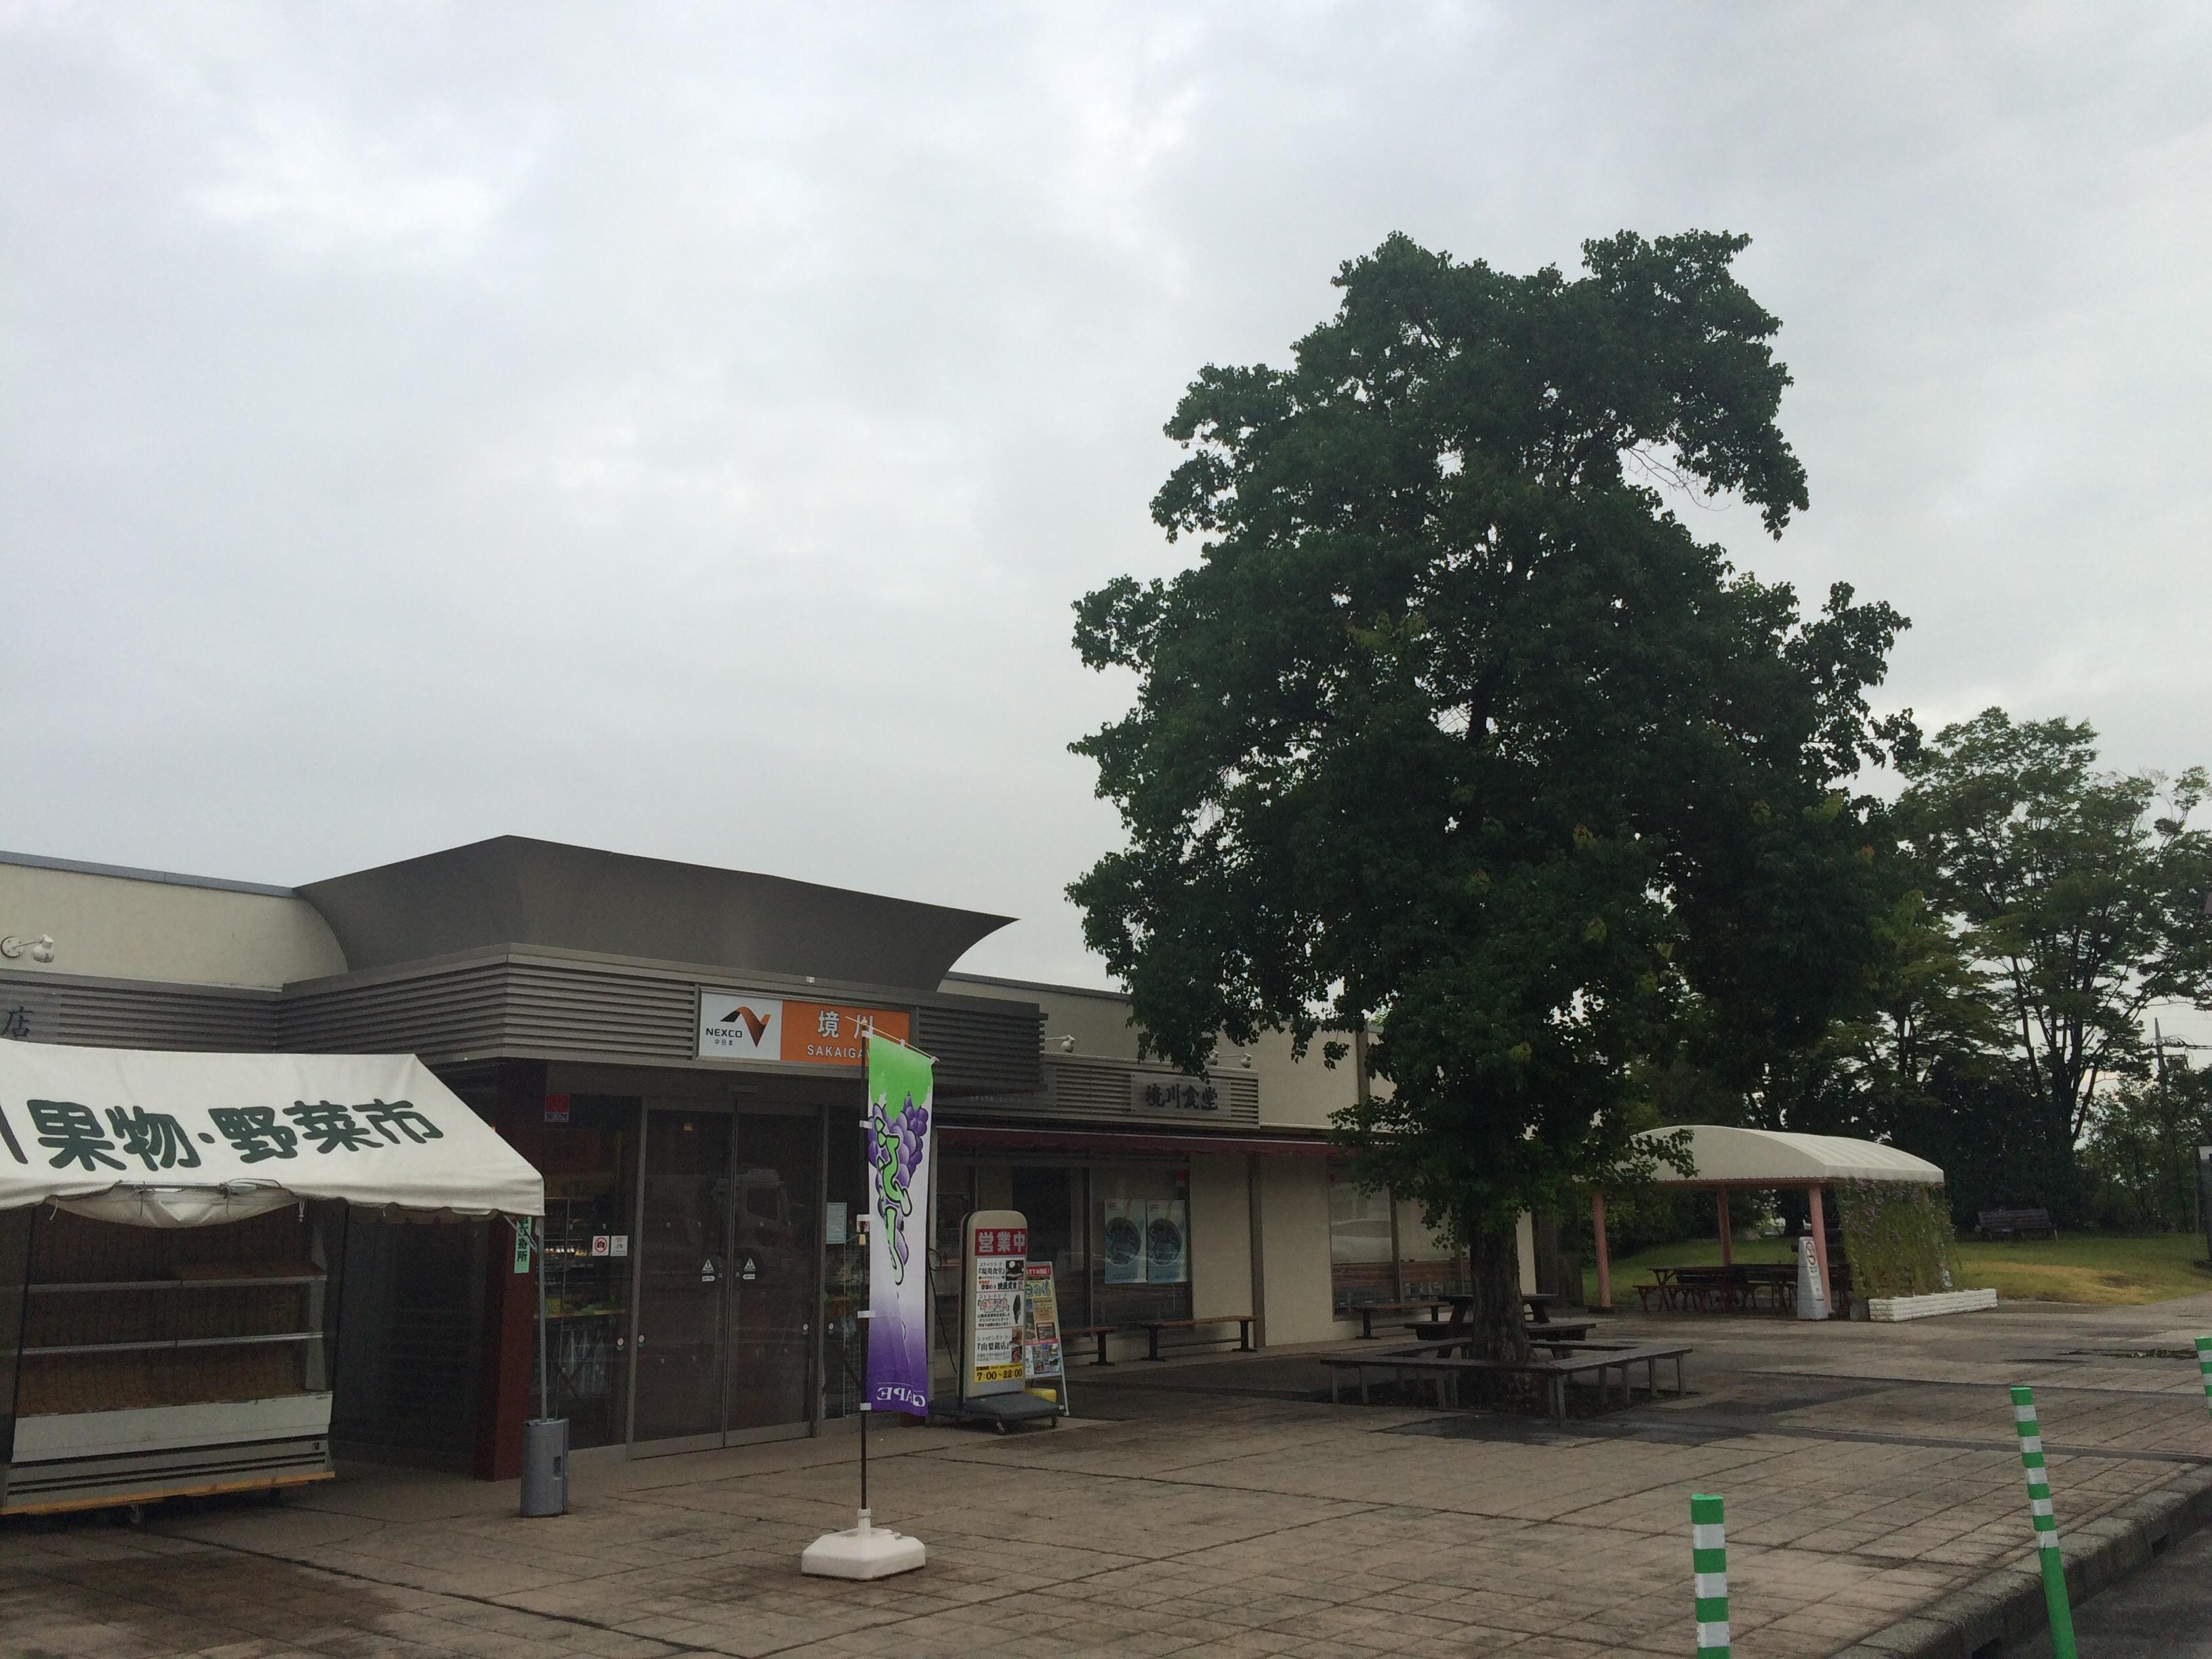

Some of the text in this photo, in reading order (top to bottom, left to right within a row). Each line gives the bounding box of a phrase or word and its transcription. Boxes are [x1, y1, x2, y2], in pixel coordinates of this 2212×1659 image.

[705, 1027, 743, 1038] NEXCO
[714, 1038, 733, 1046] 中日本
[1145, 1083, 1218, 1110] 境川食堂
[978, 1231, 1025, 1253] 営業中
